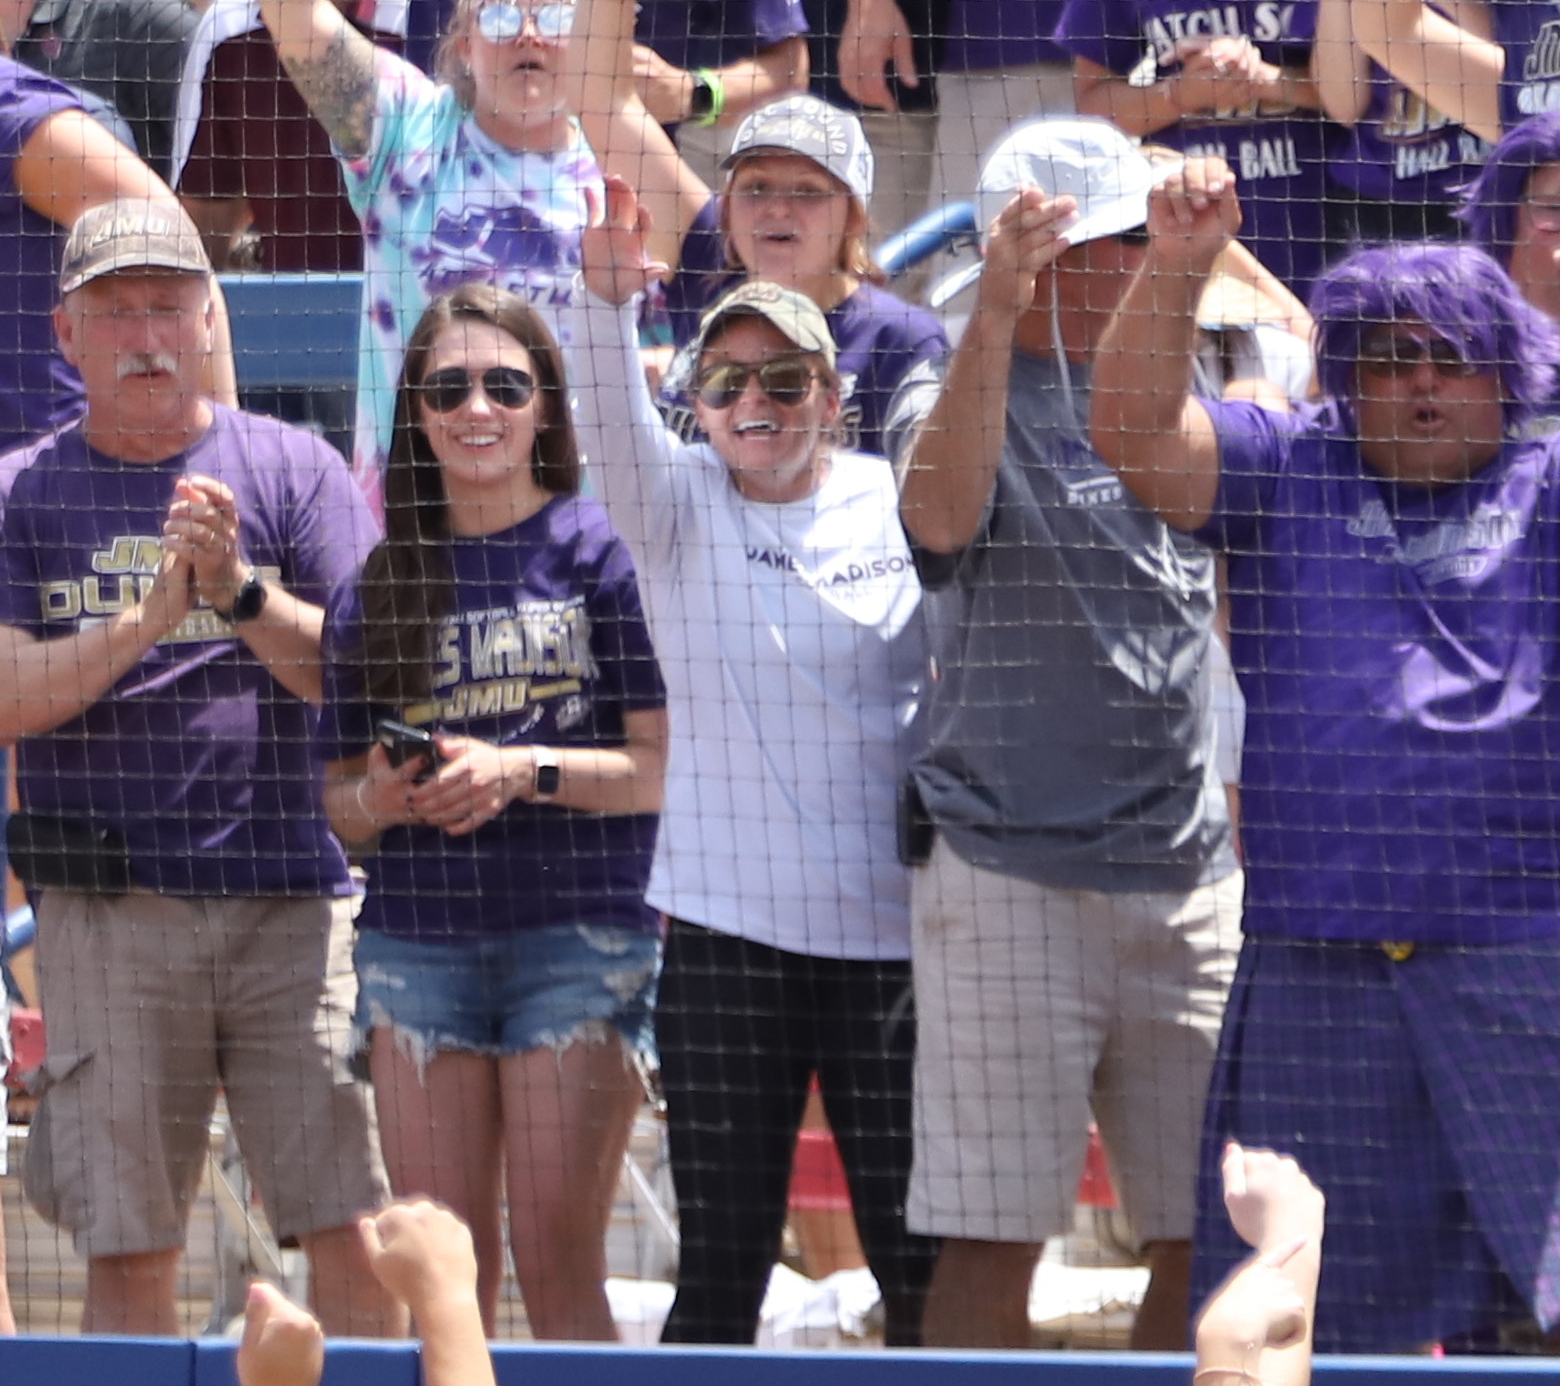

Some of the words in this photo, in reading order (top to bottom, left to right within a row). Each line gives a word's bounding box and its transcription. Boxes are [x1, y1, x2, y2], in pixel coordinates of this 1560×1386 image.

[1236, 137, 1302, 181] BALL
[91, 213, 170, 247] JMU
[442, 675, 533, 722] JMU
